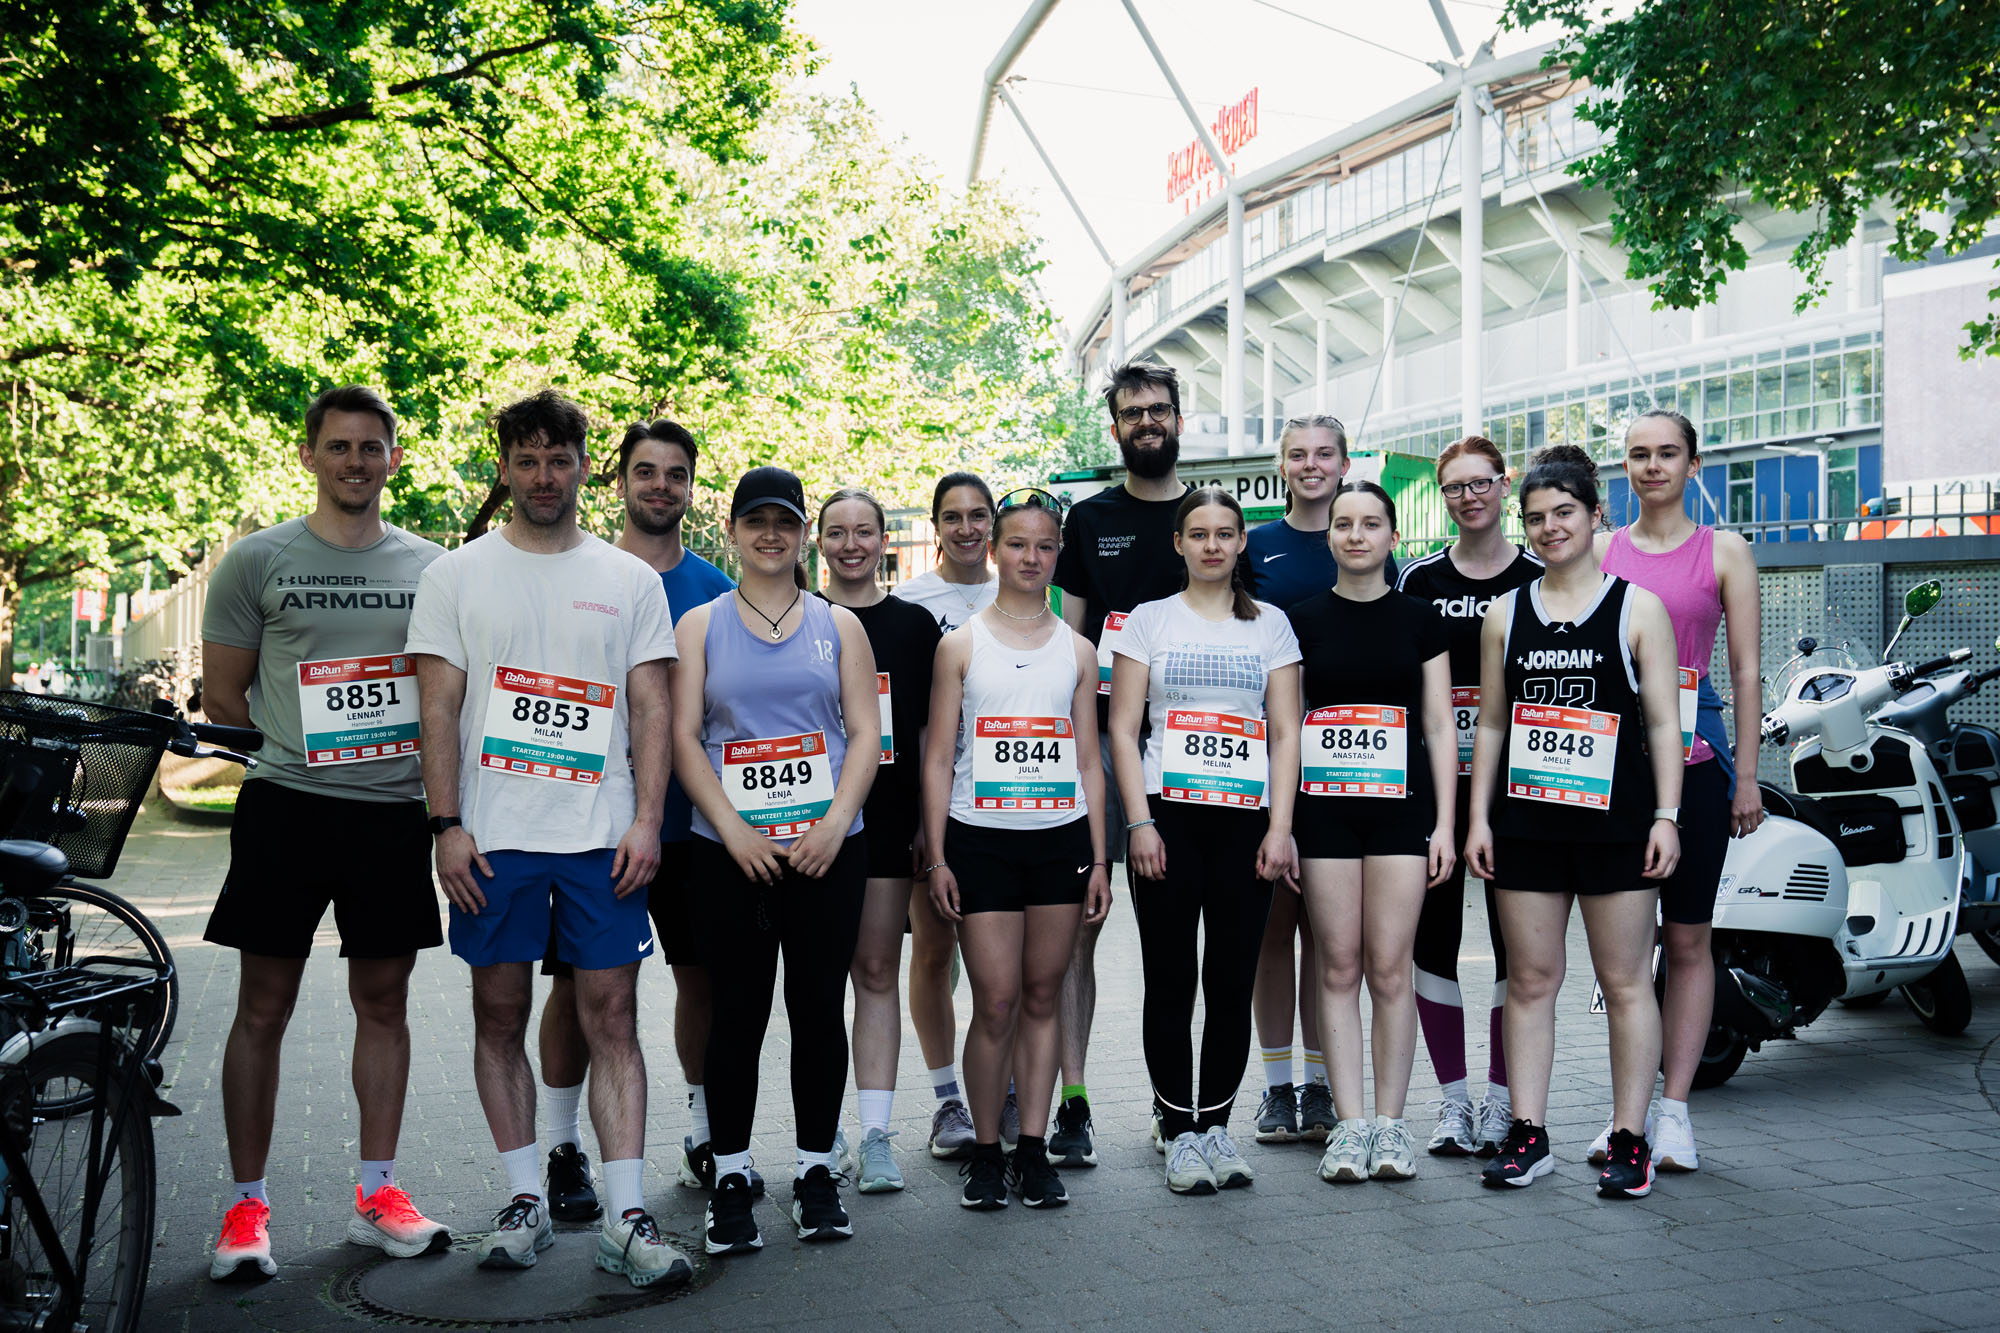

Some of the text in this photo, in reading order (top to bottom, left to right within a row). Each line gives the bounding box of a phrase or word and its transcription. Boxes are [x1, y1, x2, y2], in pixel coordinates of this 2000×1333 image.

[1098, 535, 1136, 543] HANNOVER
[298, 576, 366, 586] UNDER
[814, 640, 834, 663] 18
[1524, 649, 1594, 671] JORDAN
[310, 666, 341, 676] B2Run
[505, 671, 536, 685] B2Run
[326, 681, 400, 711] 8851
[347, 710, 386, 720] LENNART
[512, 697, 590, 731] 8853
[336, 734, 369, 743] STARTZEIT
[534, 727, 563, 739] MILAN
[1321, 728, 1387, 750] 8846
[1184, 734, 1249, 761] 8854
[1528, 729, 1594, 757] 8848
[511, 746, 546, 757] STARTZEIT
[547, 752, 565, 760] 19:00
[994, 740, 1061, 763] 8844
[1203, 760, 1232, 768] MELINA
[1543, 756, 1571, 765] AMELIE
[742, 760, 812, 790] 8849
[1019, 766, 1040, 774] JULIA
[1187, 778, 1217, 786] STARTZEIT
[1529, 774, 1555, 782] STARTZEIT
[767, 790, 792, 799] LENJA
[750, 812, 782, 820] STARTZEIT
[1840, 823, 1876, 836] Vespa
